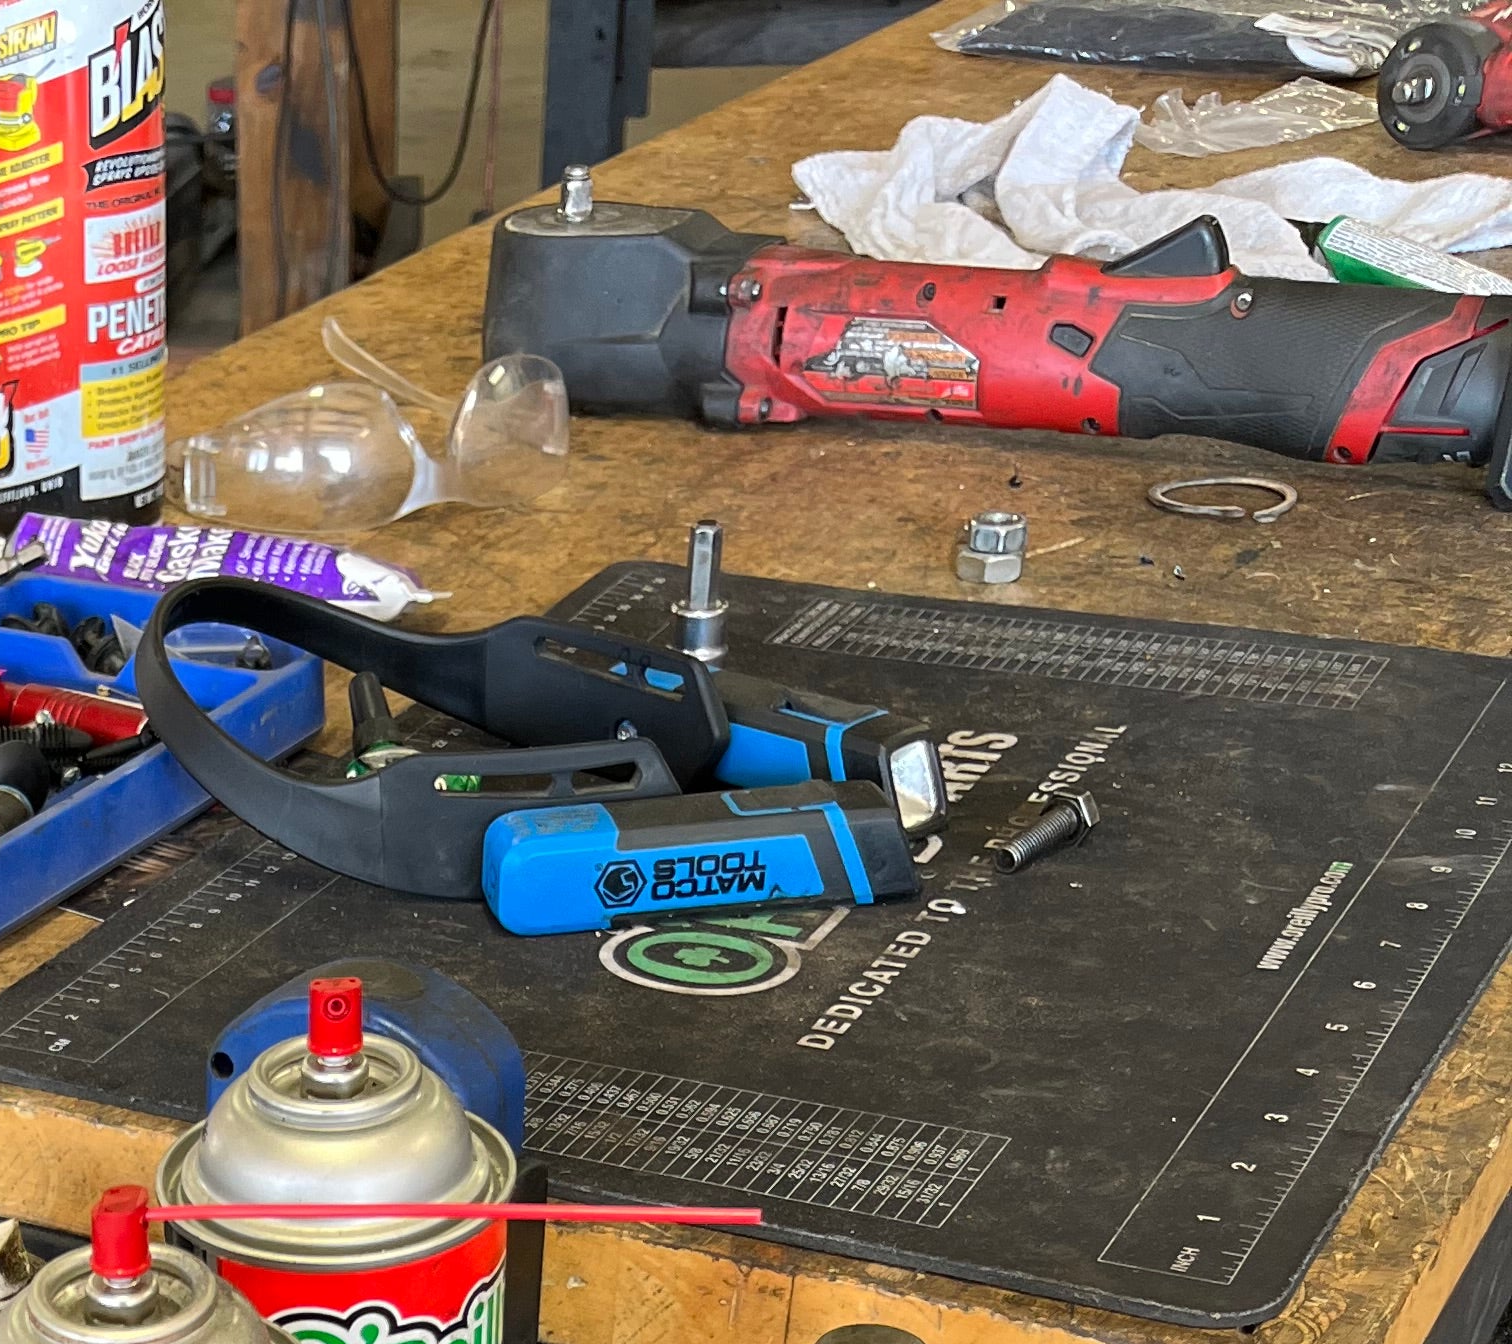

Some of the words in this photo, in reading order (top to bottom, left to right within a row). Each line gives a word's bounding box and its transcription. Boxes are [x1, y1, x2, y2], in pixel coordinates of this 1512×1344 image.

[69, 519, 112, 572] Yuko
[651, 871, 766, 901] MATCO
[652, 850, 767, 881] TOOLS
[1256, 860, 1354, 970] www.oreillypro.com
[48, 1037, 73, 1052] CM
[64, 1013, 79, 1021] 2
[128, 966, 143, 974] 5
[149, 951, 163, 959] 6
[225, 892, 243, 902] 10
[263, 864, 281, 875] 12
[796, 930, 932, 1050] DEDICATED
[914, 898, 960, 923] TO
[1170, 1246, 1200, 1273] INCH
[1196, 1213, 1221, 1222] 1
[1230, 1160, 1257, 1172] 2
[1263, 1112, 1289, 1124] 3
[1295, 1067, 1320, 1078] 4
[1324, 1021, 1350, 1032] 5
[1352, 980, 1377, 991] 6
[1379, 939, 1402, 949] 7
[1405, 901, 1429, 910] 8
[1430, 865, 1453, 874] 9
[1453, 828, 1477, 840] 10
[1475, 796, 1498, 806] 11
[544, 1112, 572, 1132] 13/32
[563, 1120, 587, 1137] 7/16
[596, 1084, 622, 1105] 0.437
[584, 1120, 611, 1140] 15/32
[616, 1088, 642, 1109] 0.467
[604, 1131, 623, 1145] 1/2
[636, 1092, 663, 1112] 0.500
[624, 1127, 651, 1148] 17/32
[655, 1096, 682, 1116] 0.531
[664, 1135, 691, 1156] 19/32
[695, 1103, 722, 1123] 0.594
[684, 1147, 704, 1160] 5/8
[715, 1106, 742, 1127] 0.625
[704, 1143, 732, 1164] 21/32
[726, 1148, 751, 1167] 11/16
[756, 1114, 782, 1134] 0.687
[745, 1151, 773, 1172] 23/32
[776, 1117, 803, 1138] 0.719
[766, 1162, 786, 1176] 3/4
[797, 1121, 823, 1142] 0.750
[788, 1158, 815, 1180] 25/32
[818, 1126, 844, 1146] 0.781
[830, 1166, 857, 1188] 27/32
[859, 1132, 885, 1153] 0.844
[850, 1178, 871, 1192] 7/8
[880, 1136, 907, 1157] 0.875
[809, 1162, 836, 1183] 13/16
[873, 1174, 901, 1196] 29/32
[895, 1179, 923, 1200] 15/16
[923, 1144, 948, 1165] 0.937
[915, 1183, 944, 1204] 31/32
